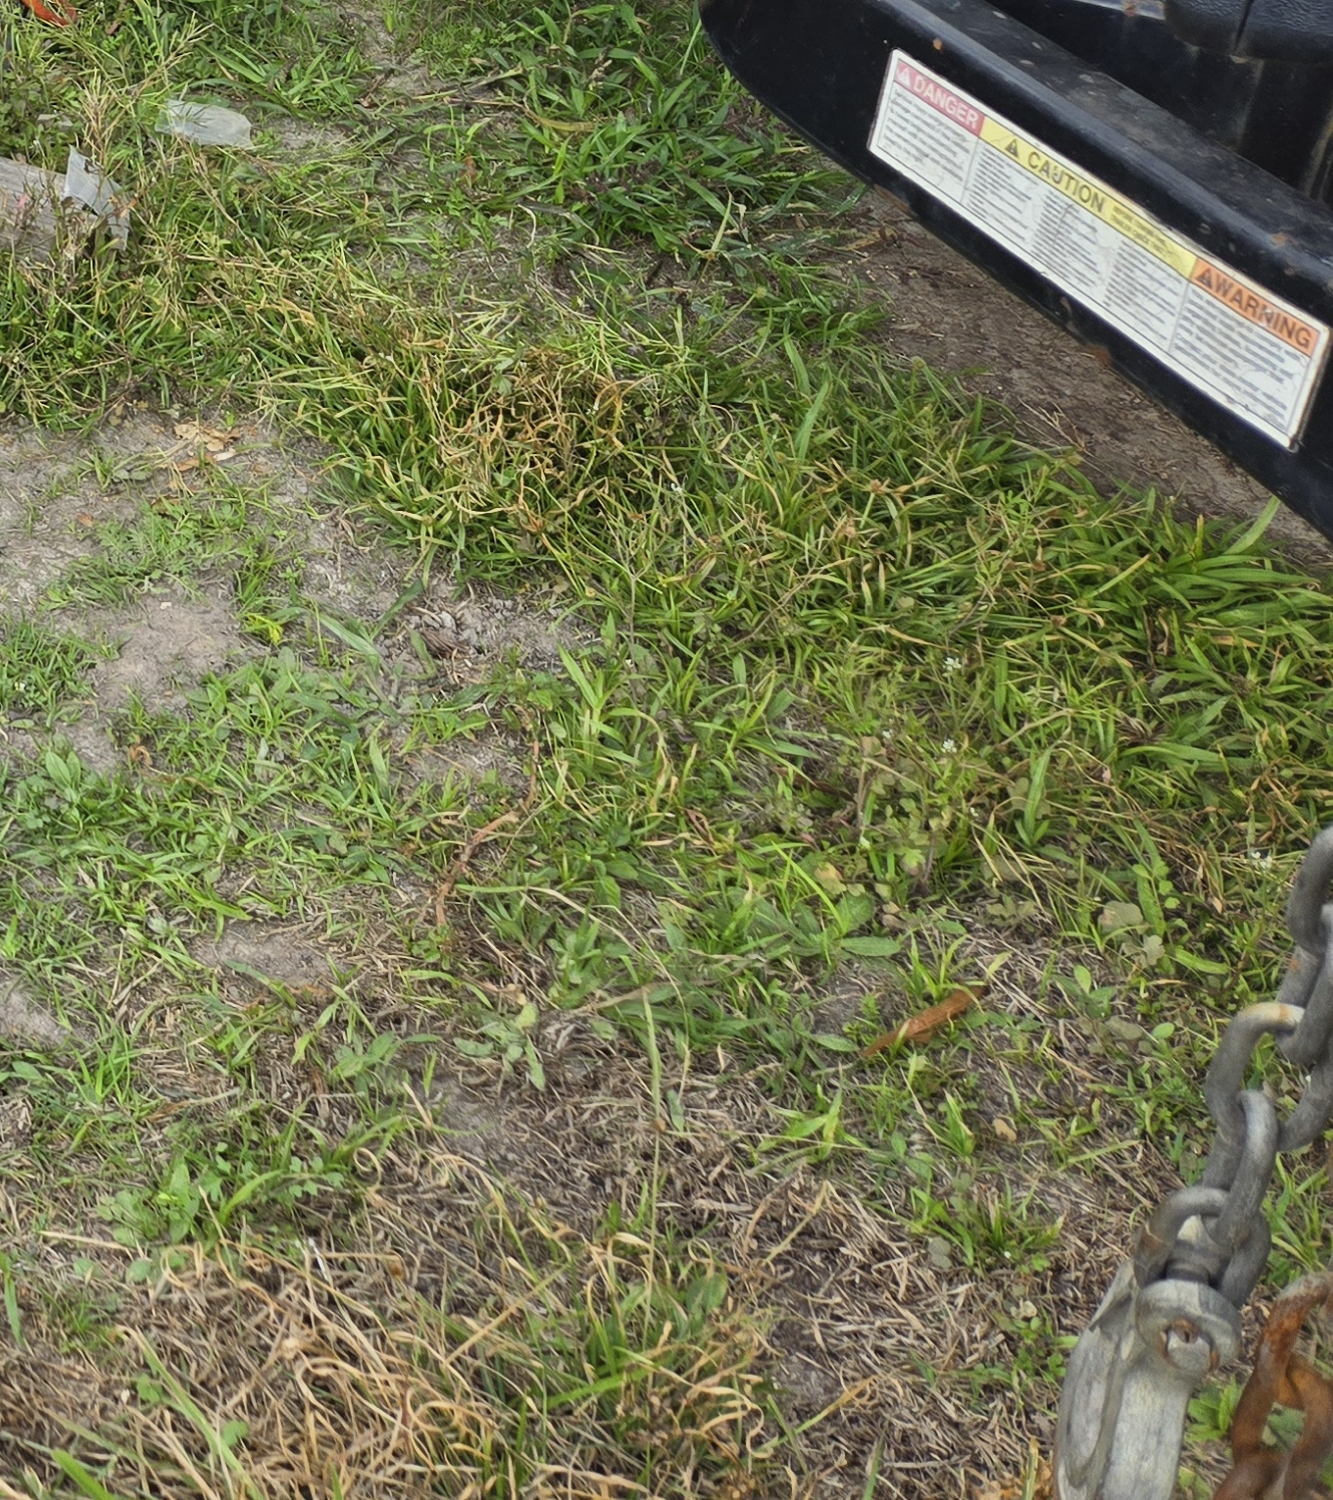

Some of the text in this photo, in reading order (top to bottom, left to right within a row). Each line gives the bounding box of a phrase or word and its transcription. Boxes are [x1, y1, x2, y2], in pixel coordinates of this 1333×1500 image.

[913, 74, 980, 129] DANGER
[1028, 151, 1106, 213] CAUTION
[1215, 273, 1312, 350] WARNING
